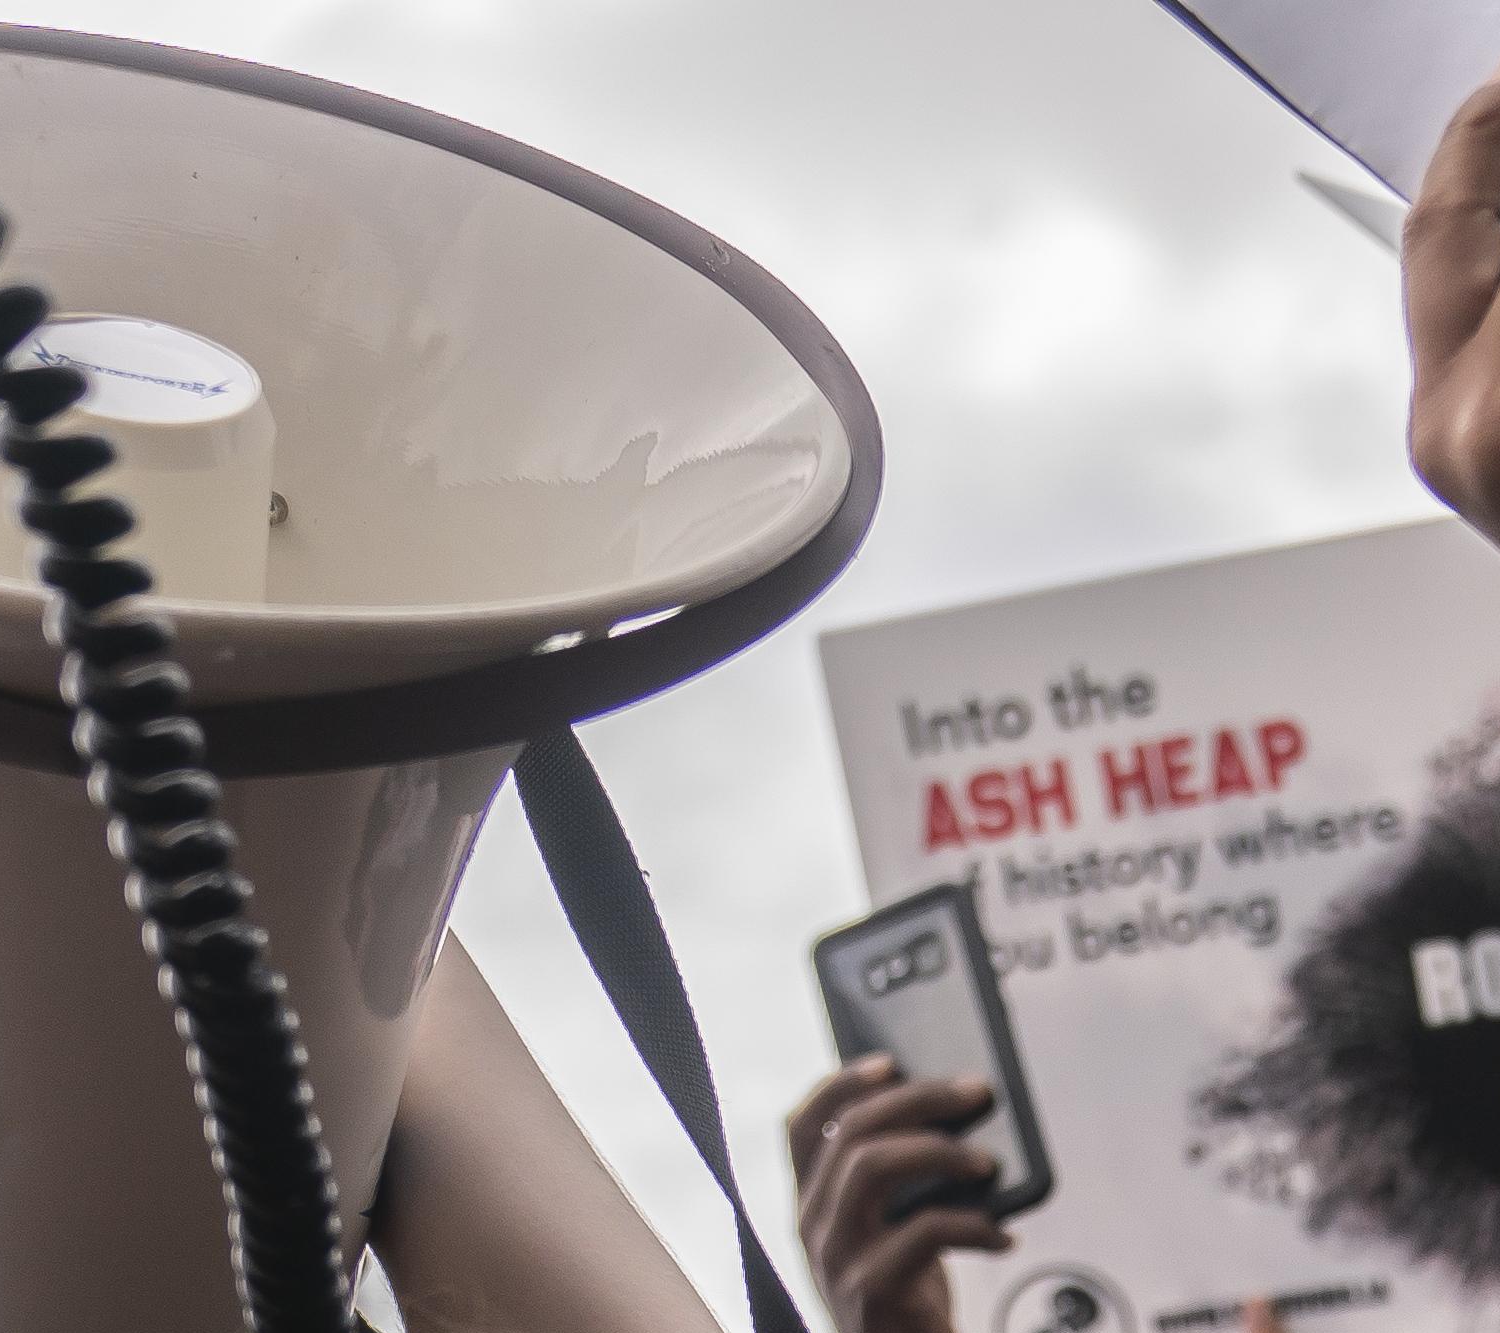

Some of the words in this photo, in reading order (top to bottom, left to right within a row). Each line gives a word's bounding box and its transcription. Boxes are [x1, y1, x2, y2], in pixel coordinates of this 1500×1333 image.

[899, 697, 1033, 758] Into
[1047, 667, 1156, 730] the
[923, 756, 1078, 855] ASH
[1097, 716, 1310, 820] HEAP
[1000, 840, 1202, 905] history
[1217, 806, 1402, 870] where
[1066, 892, 1281, 964] belong
